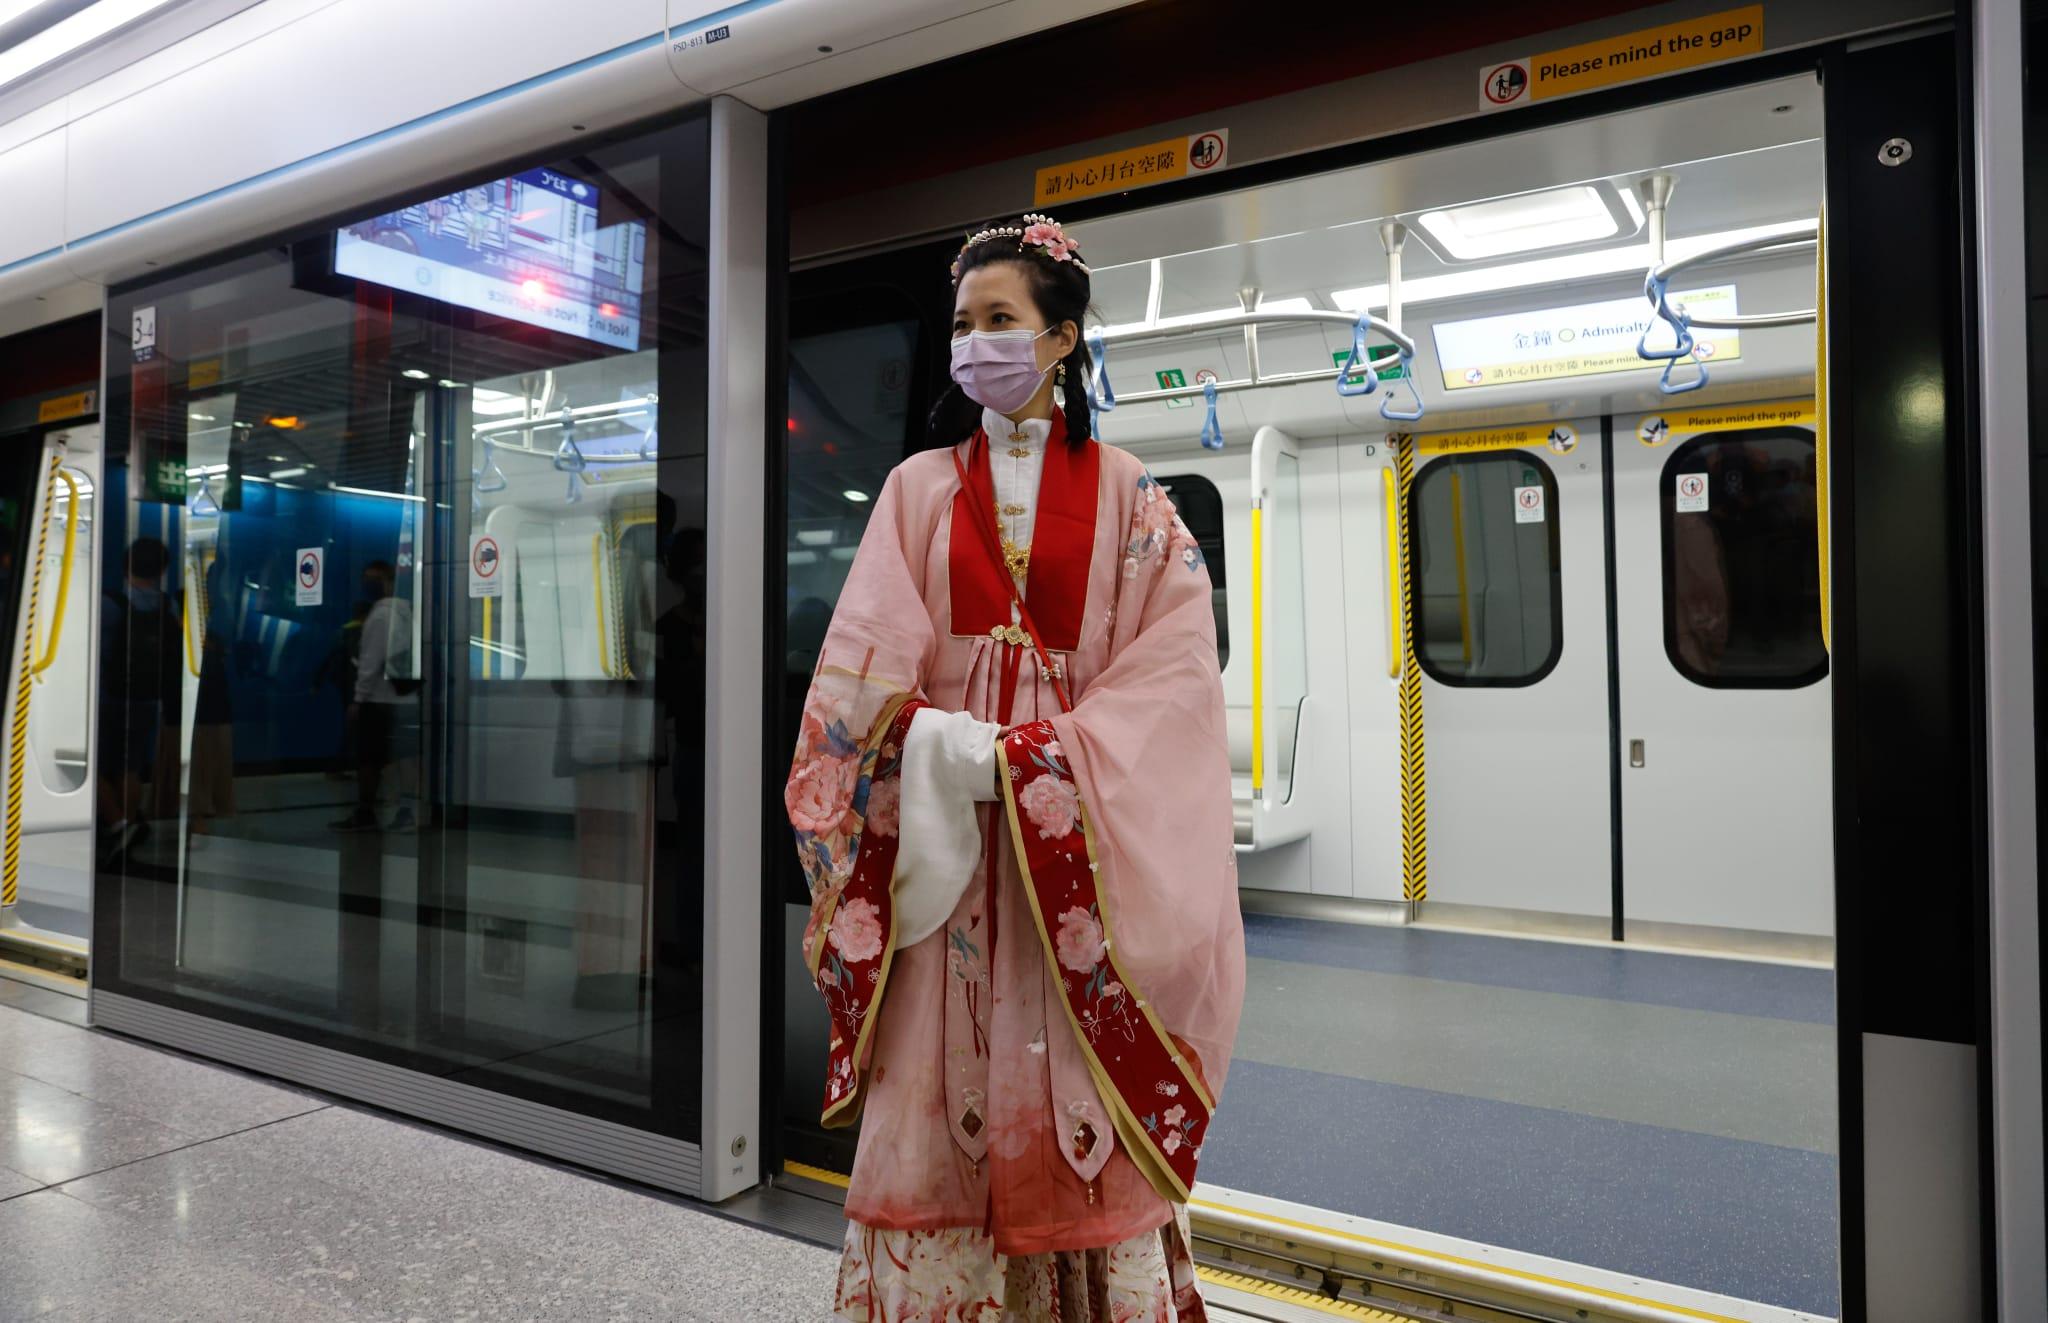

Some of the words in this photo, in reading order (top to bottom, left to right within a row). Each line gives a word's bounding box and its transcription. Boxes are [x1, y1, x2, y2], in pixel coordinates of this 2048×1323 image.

[673, 36, 703, 52] PSD-813
[1540, 56, 1603, 81] Please
[1608, 40, 1662, 66] mind
[1668, 36, 1703, 53] the
[1709, 24, 1752, 47] gap
[1045, 150, 1176, 195] 請小心月台空隙
[1581, 321, 1649, 338] Admiralt
[1583, 357, 1615, 368] Please
[1688, 415, 1723, 427] Please
[1725, 413, 1756, 423] mind
[1757, 411, 1777, 422] the
[1779, 409, 1802, 421] gap
[1366, 445, 1375, 457] D
